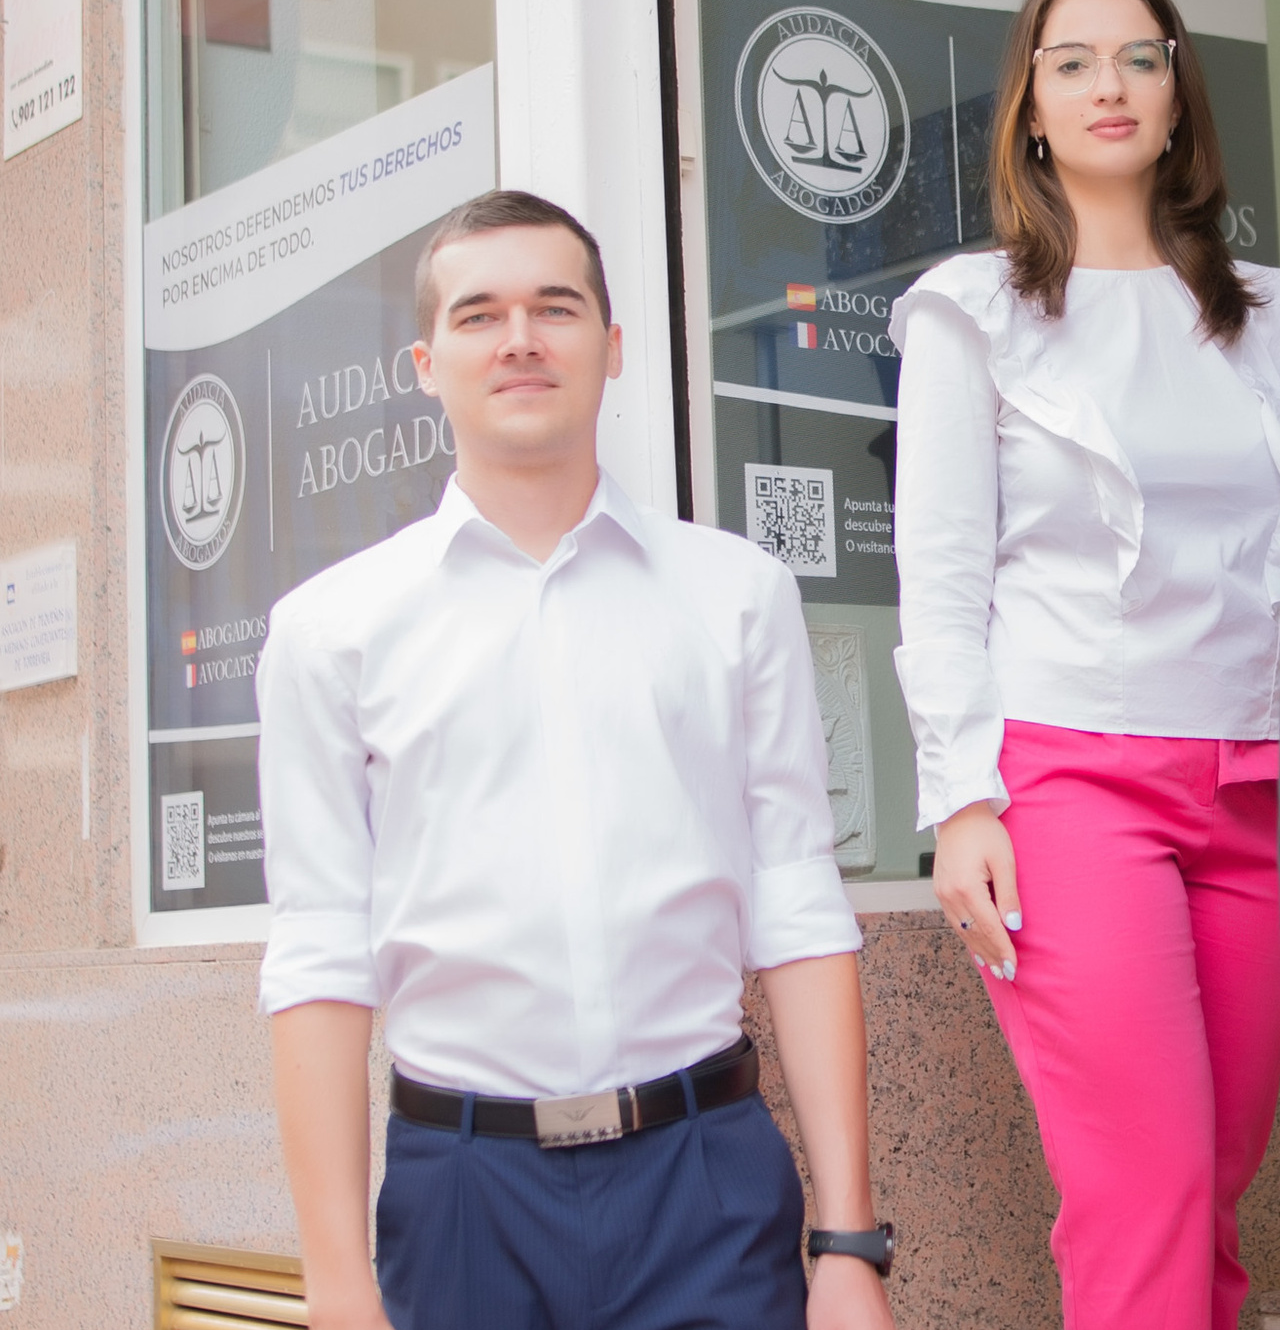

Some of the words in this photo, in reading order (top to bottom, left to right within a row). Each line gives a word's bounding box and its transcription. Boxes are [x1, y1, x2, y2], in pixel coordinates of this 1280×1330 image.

[776, 15, 871, 63] AUDACIA
[18, 98, 35, 126] 902
[39, 86, 54, 115] 121
[58, 74, 76, 102] 122
[161, 225, 233, 276] NOSOTROS
[235, 179, 336, 243] DEFENDEMOS
[339, 163, 369, 197] TUS
[371, 120, 464, 183] DERECHOS
[770, 170, 884, 216] ABOGADOS
[161, 279, 190, 309] POR
[192, 256, 245, 296] ENCIMA
[247, 249, 267, 273] DE
[269, 226, 315, 259] TODO.
[820, 288, 893, 319] ABOG
[178, 379, 228, 421] AUDACIA
[295, 345, 423, 430] AUDAC
[843, 496, 882, 514] Apunta
[883, 501, 895, 514] tu
[844, 517, 893, 533] descubre
[174, 517, 232, 564] ABOGADOS
[845, 539, 855, 552] O
[197, 615, 268, 651] ABOGADOS
[198, 653, 256, 686] AVOCATS
